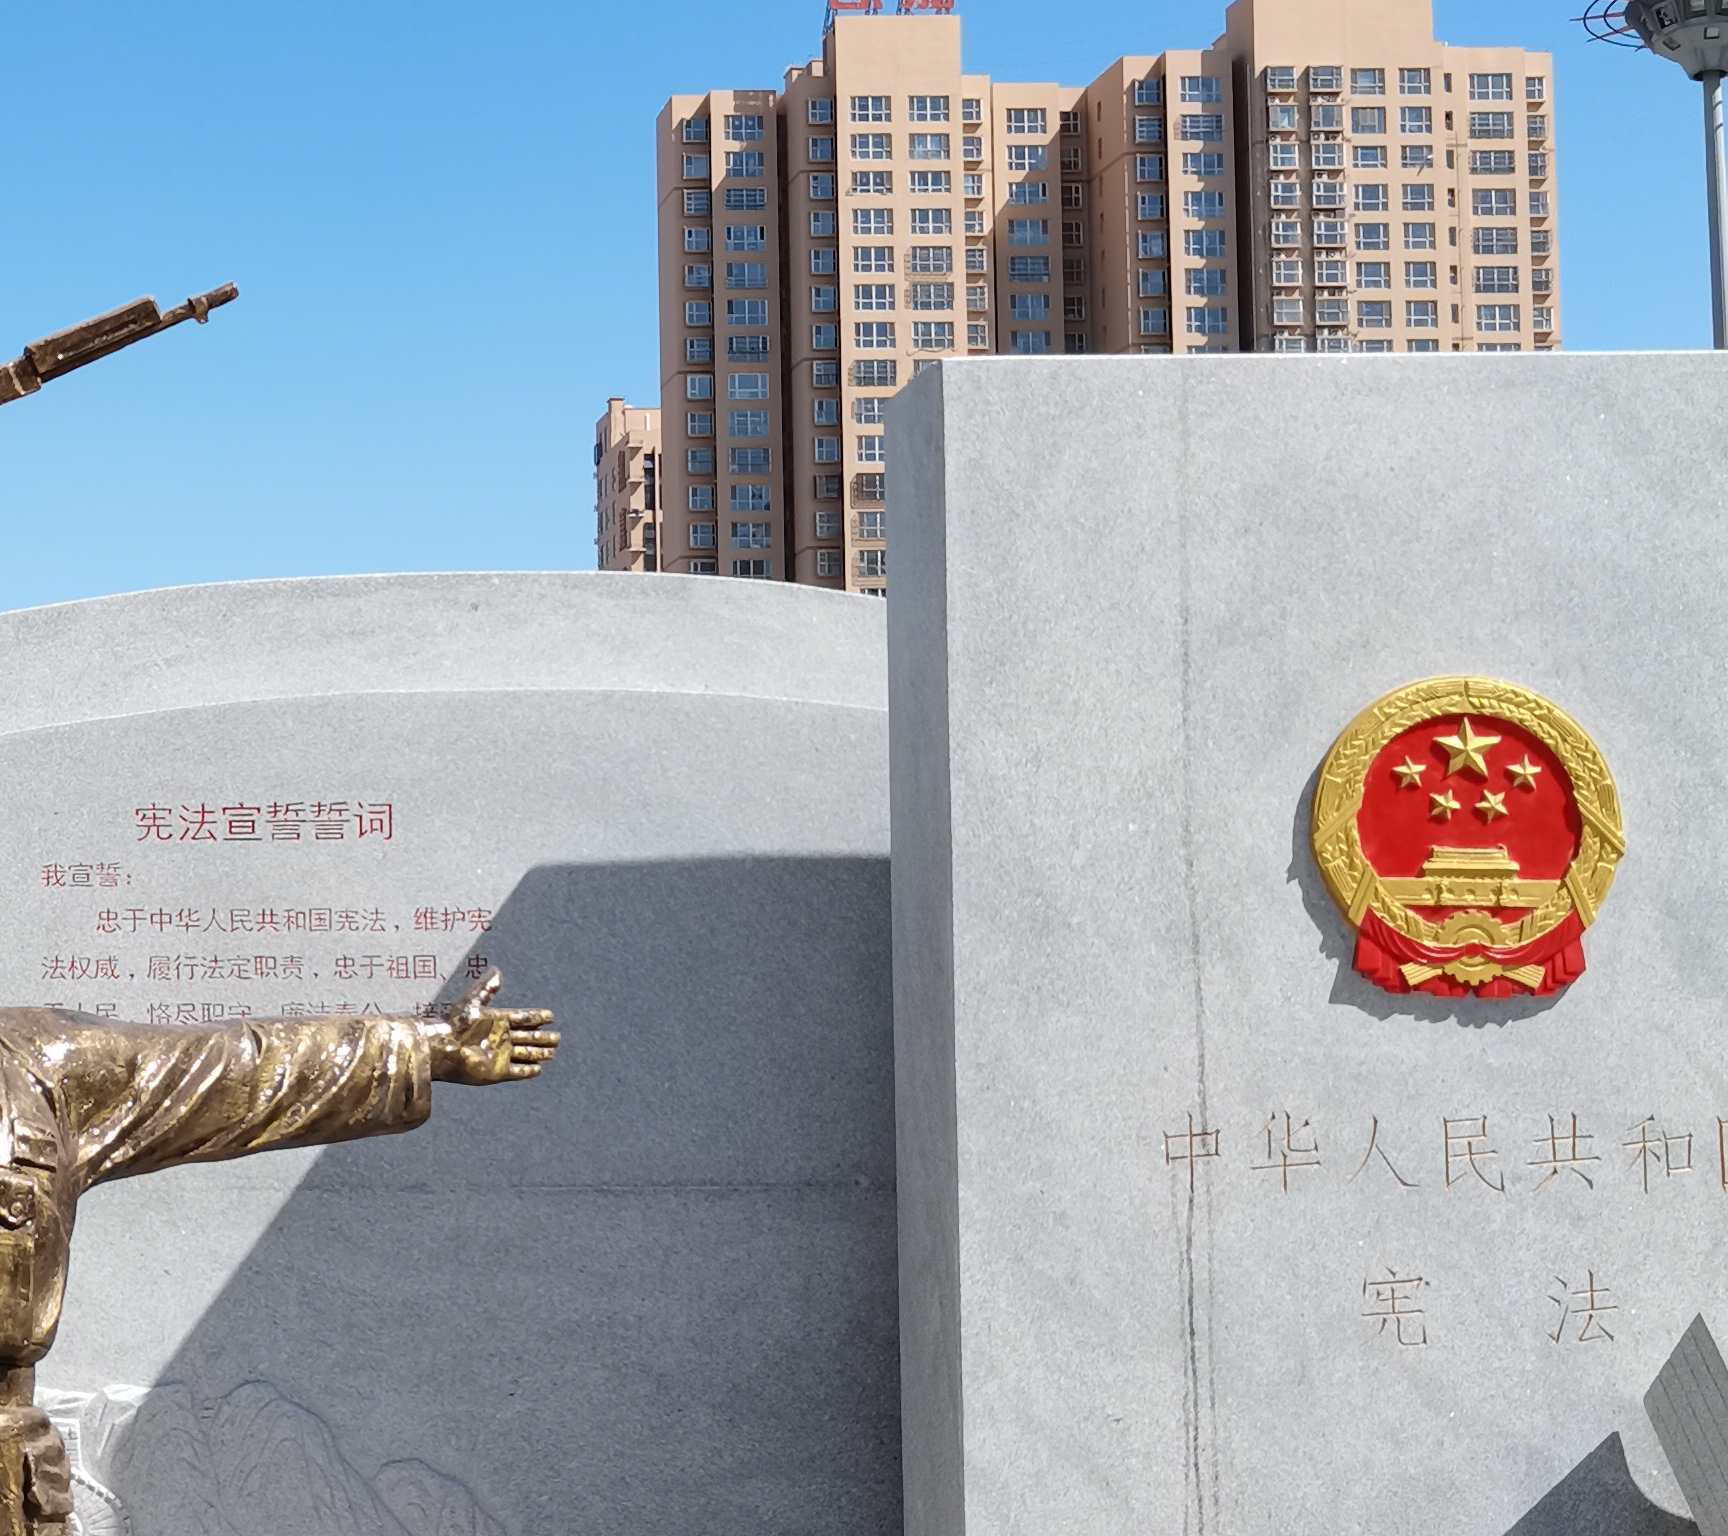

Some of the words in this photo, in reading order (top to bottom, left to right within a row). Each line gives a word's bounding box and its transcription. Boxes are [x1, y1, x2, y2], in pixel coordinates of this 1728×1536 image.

[135, 802, 393, 841] 宪法宣誓誓词
[1163, 1112, 1728, 1194] 中华人民共和
[1362, 1268, 1619, 1346] 宪法
